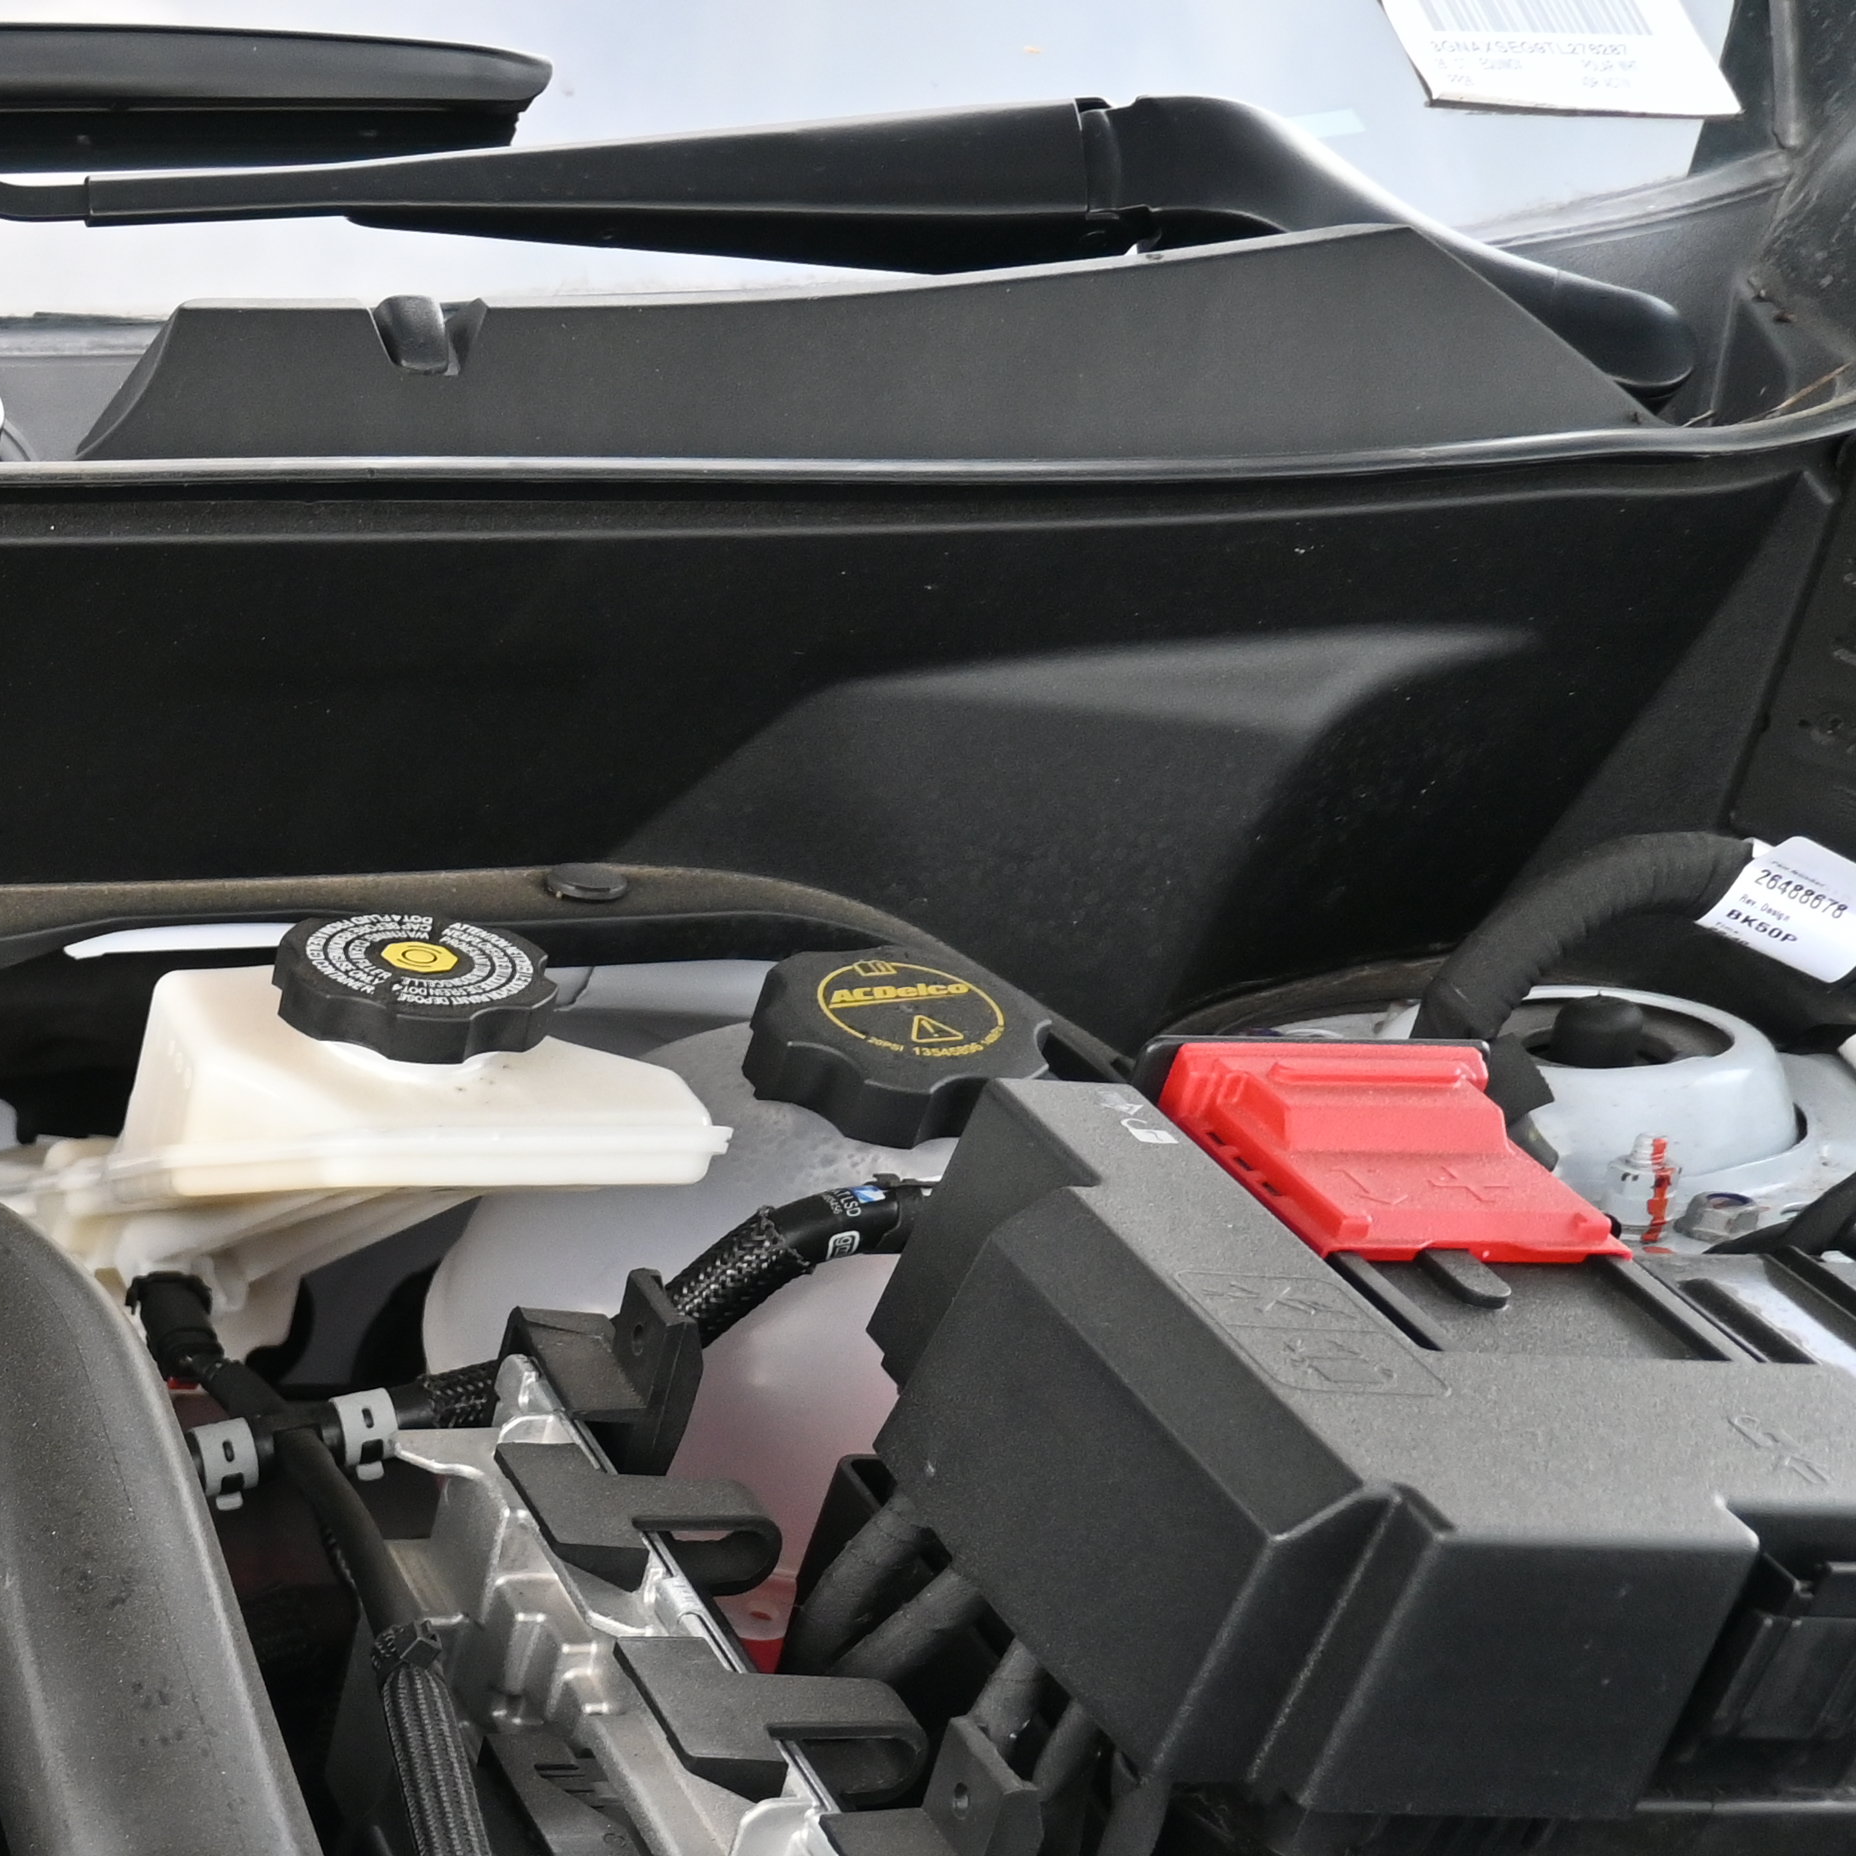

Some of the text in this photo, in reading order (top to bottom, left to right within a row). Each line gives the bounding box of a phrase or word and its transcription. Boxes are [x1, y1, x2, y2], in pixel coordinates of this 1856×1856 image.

[1754, 868, 1848, 919] 26488678
[1726, 908, 1798, 943] BK50P
[829, 982, 970, 1005] ACDelco
